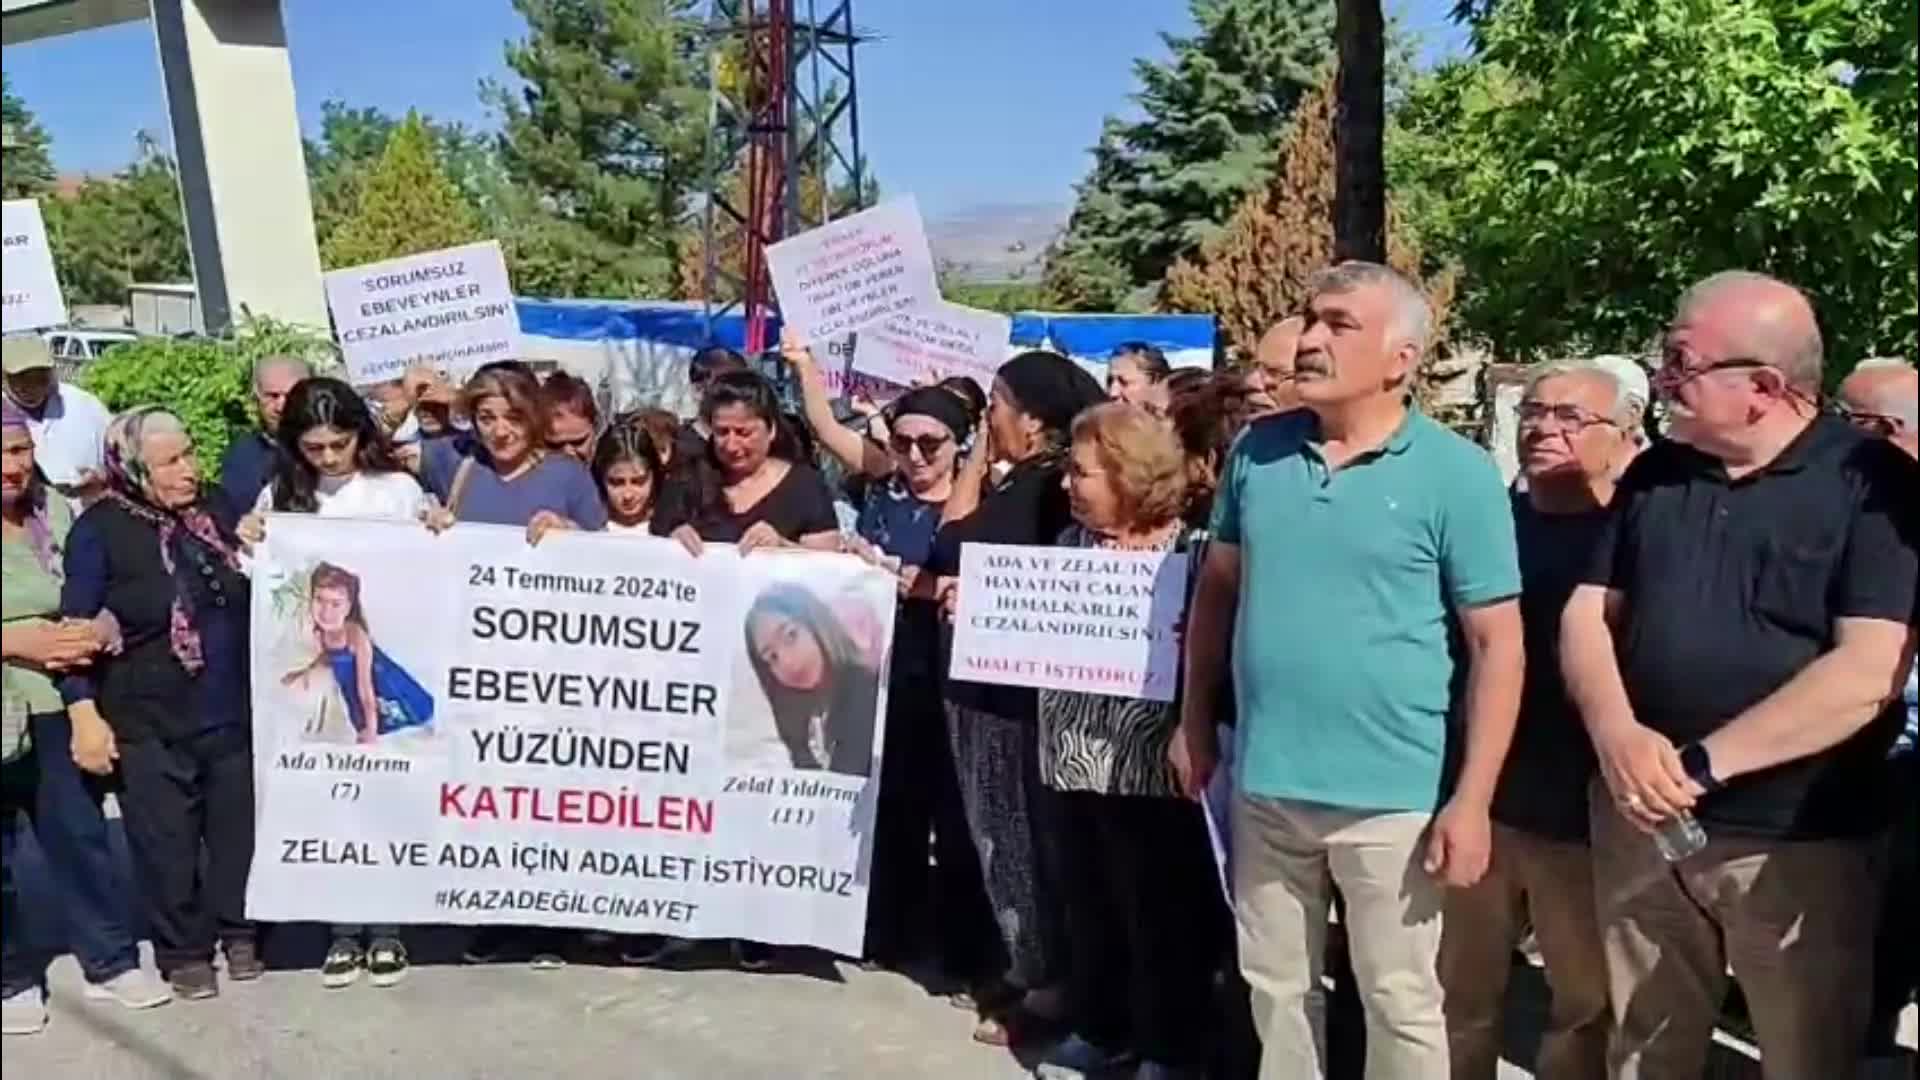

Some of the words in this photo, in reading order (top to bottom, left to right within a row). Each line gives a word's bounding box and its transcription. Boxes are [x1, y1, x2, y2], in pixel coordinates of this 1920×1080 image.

[360, 283, 481, 317] EBEVEYNLER
[984, 555, 1023, 571] ADA
[468, 563, 496, 587] 24
[503, 566, 606, 595] Temmuz
[612, 575, 697, 602] 2024'te
[471, 605, 701, 654] SORUMSUZ
[447, 666, 719, 717] EBEVEYNLER
[275, 751, 317, 771] Ada
[322, 751, 412, 774] Yıldırım
[471, 725, 690, 775] YÜZÜNDEN
[330, 781, 361, 802] (7)
[722, 775, 774, 796] Zelal
[439, 782, 714, 834] KATLEDİLEN
[770, 807, 816, 829] (11)
[279, 839, 379, 867] ZELAL
[388, 842, 429, 867] VE
[437, 843, 502, 871] ADA
[510, 842, 569, 877] İÇİN
[578, 848, 698, 883] ADALET
[702, 854, 854, 898] İSTİYORUZ
[434, 888, 700, 925] #KAZADEĞİLCİNAYET
